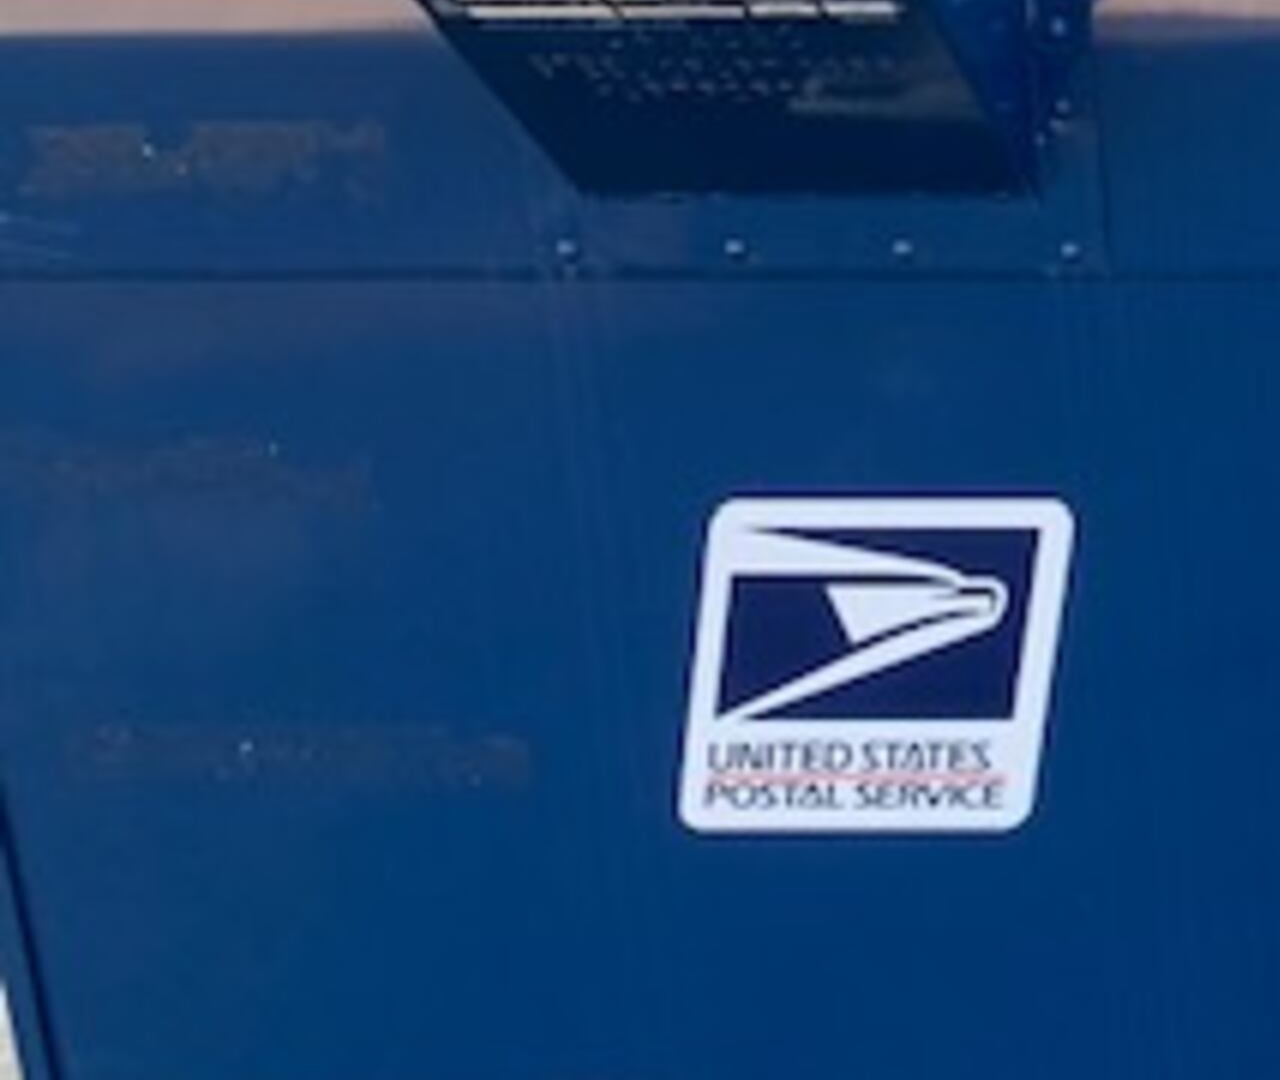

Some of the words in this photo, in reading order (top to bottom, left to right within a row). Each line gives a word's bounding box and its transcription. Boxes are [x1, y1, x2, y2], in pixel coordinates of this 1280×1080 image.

[705, 741, 853, 772] UNITED
[861, 741, 992, 771] STATES
[703, 781, 840, 810] POSTAL
[853, 781, 1005, 809] SERVICE
